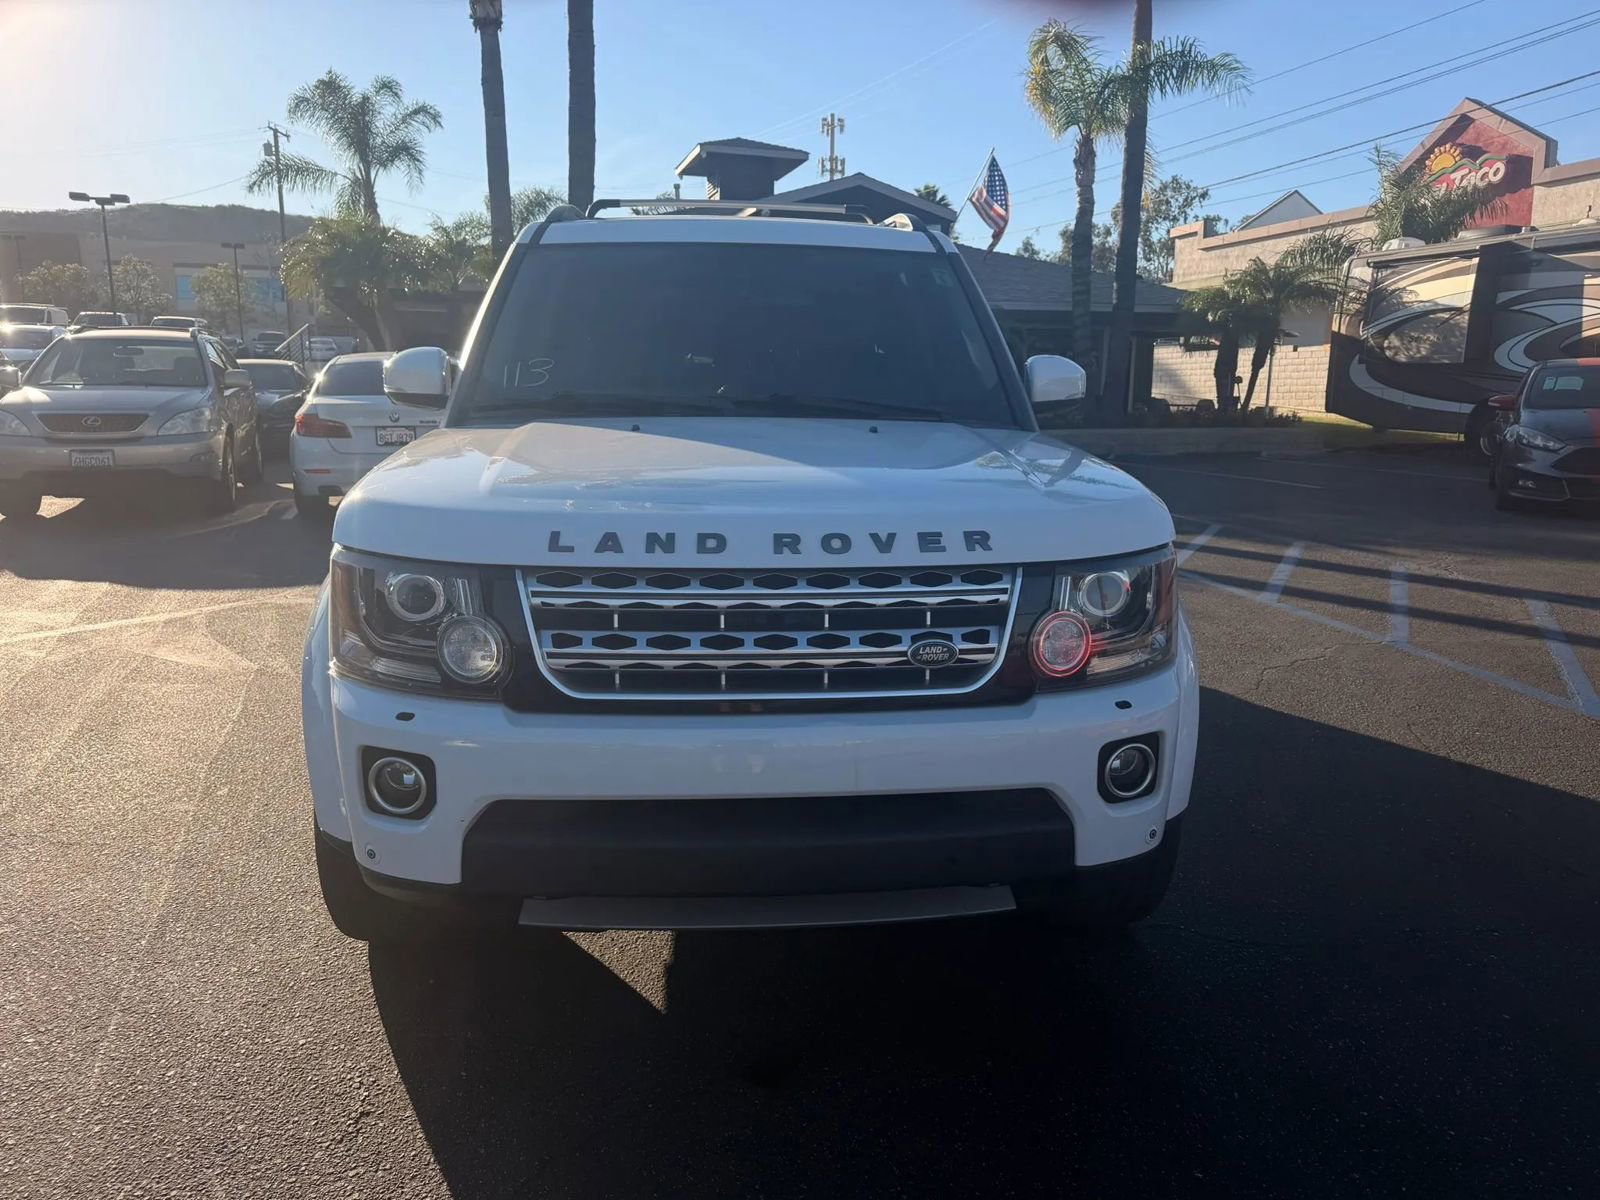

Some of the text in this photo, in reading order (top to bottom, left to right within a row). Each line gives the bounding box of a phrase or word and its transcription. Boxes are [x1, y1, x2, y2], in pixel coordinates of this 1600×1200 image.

[1450, 161, 1506, 189] TACO
[503, 358, 555, 389] 113
[548, 530, 993, 555] LAND ROVER
[919, 646, 942, 654] LAND
[920, 653, 950, 661] ROVER
